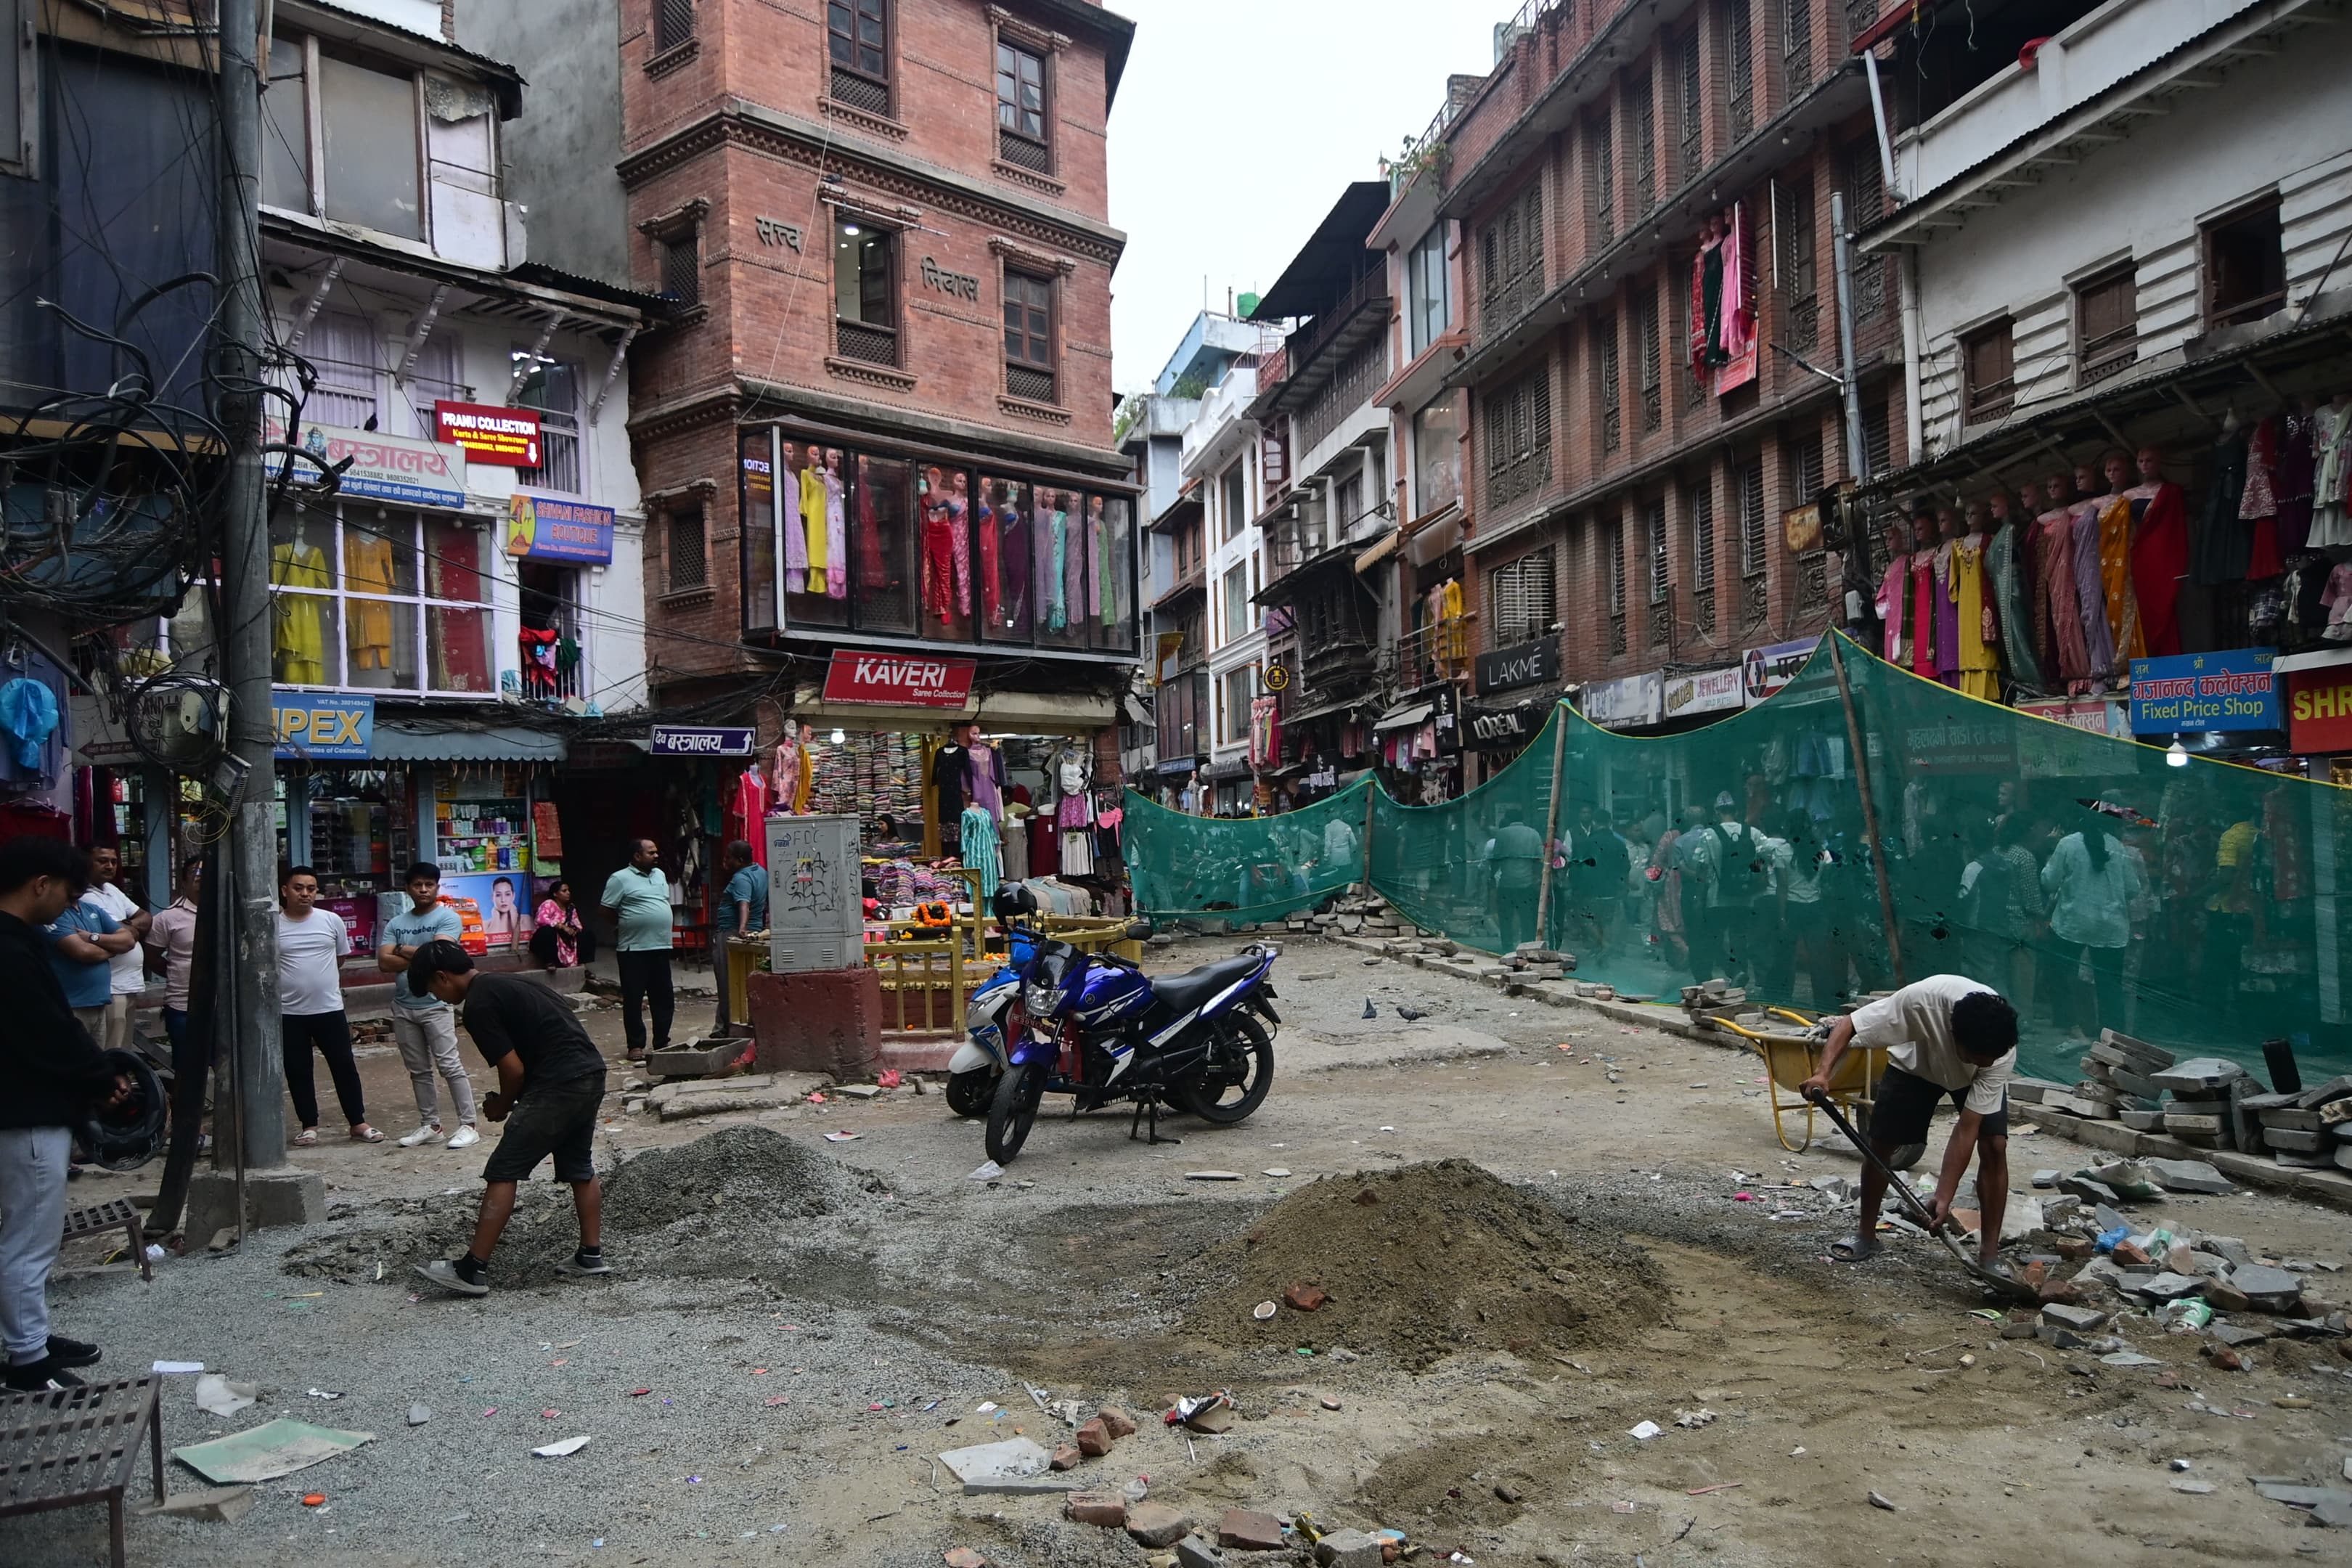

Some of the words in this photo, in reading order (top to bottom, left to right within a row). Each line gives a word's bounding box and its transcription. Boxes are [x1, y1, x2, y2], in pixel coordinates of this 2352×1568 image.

[921, 255, 979, 301] निवास
[442, 412, 476, 429] PRANU
[477, 417, 536, 435] COLLECTION
[452, 429, 471, 438] Kurta
[472, 431, 478, 440] &
[536, 501, 572, 521] SHIVANI
[573, 507, 611, 526] FASHION
[551, 523, 597, 544] BOUTIQUE
[854, 658, 947, 687] KAVERI
[1489, 646, 1542, 686] LAKMÉ
[2134, 663, 2149, 679] शुभ
[2194, 656, 2204, 669] श्री
[912, 688, 932, 697] Saree
[934, 690, 965, 698] Collection
[1697, 672, 1739, 698] JEWELLERY
[2133, 677, 2196, 701] गजानन्द
[2199, 668, 2273, 695] कलेक्सन
[2142, 702, 2179, 719] Fixed
[2184, 699, 2220, 717] Price
[2224, 698, 2263, 717] Shop
[656, 730, 666, 744] देव
[668, 734, 723, 751] बस्त्रालय
[1103, 1094, 1130, 1106] YAMAHA
